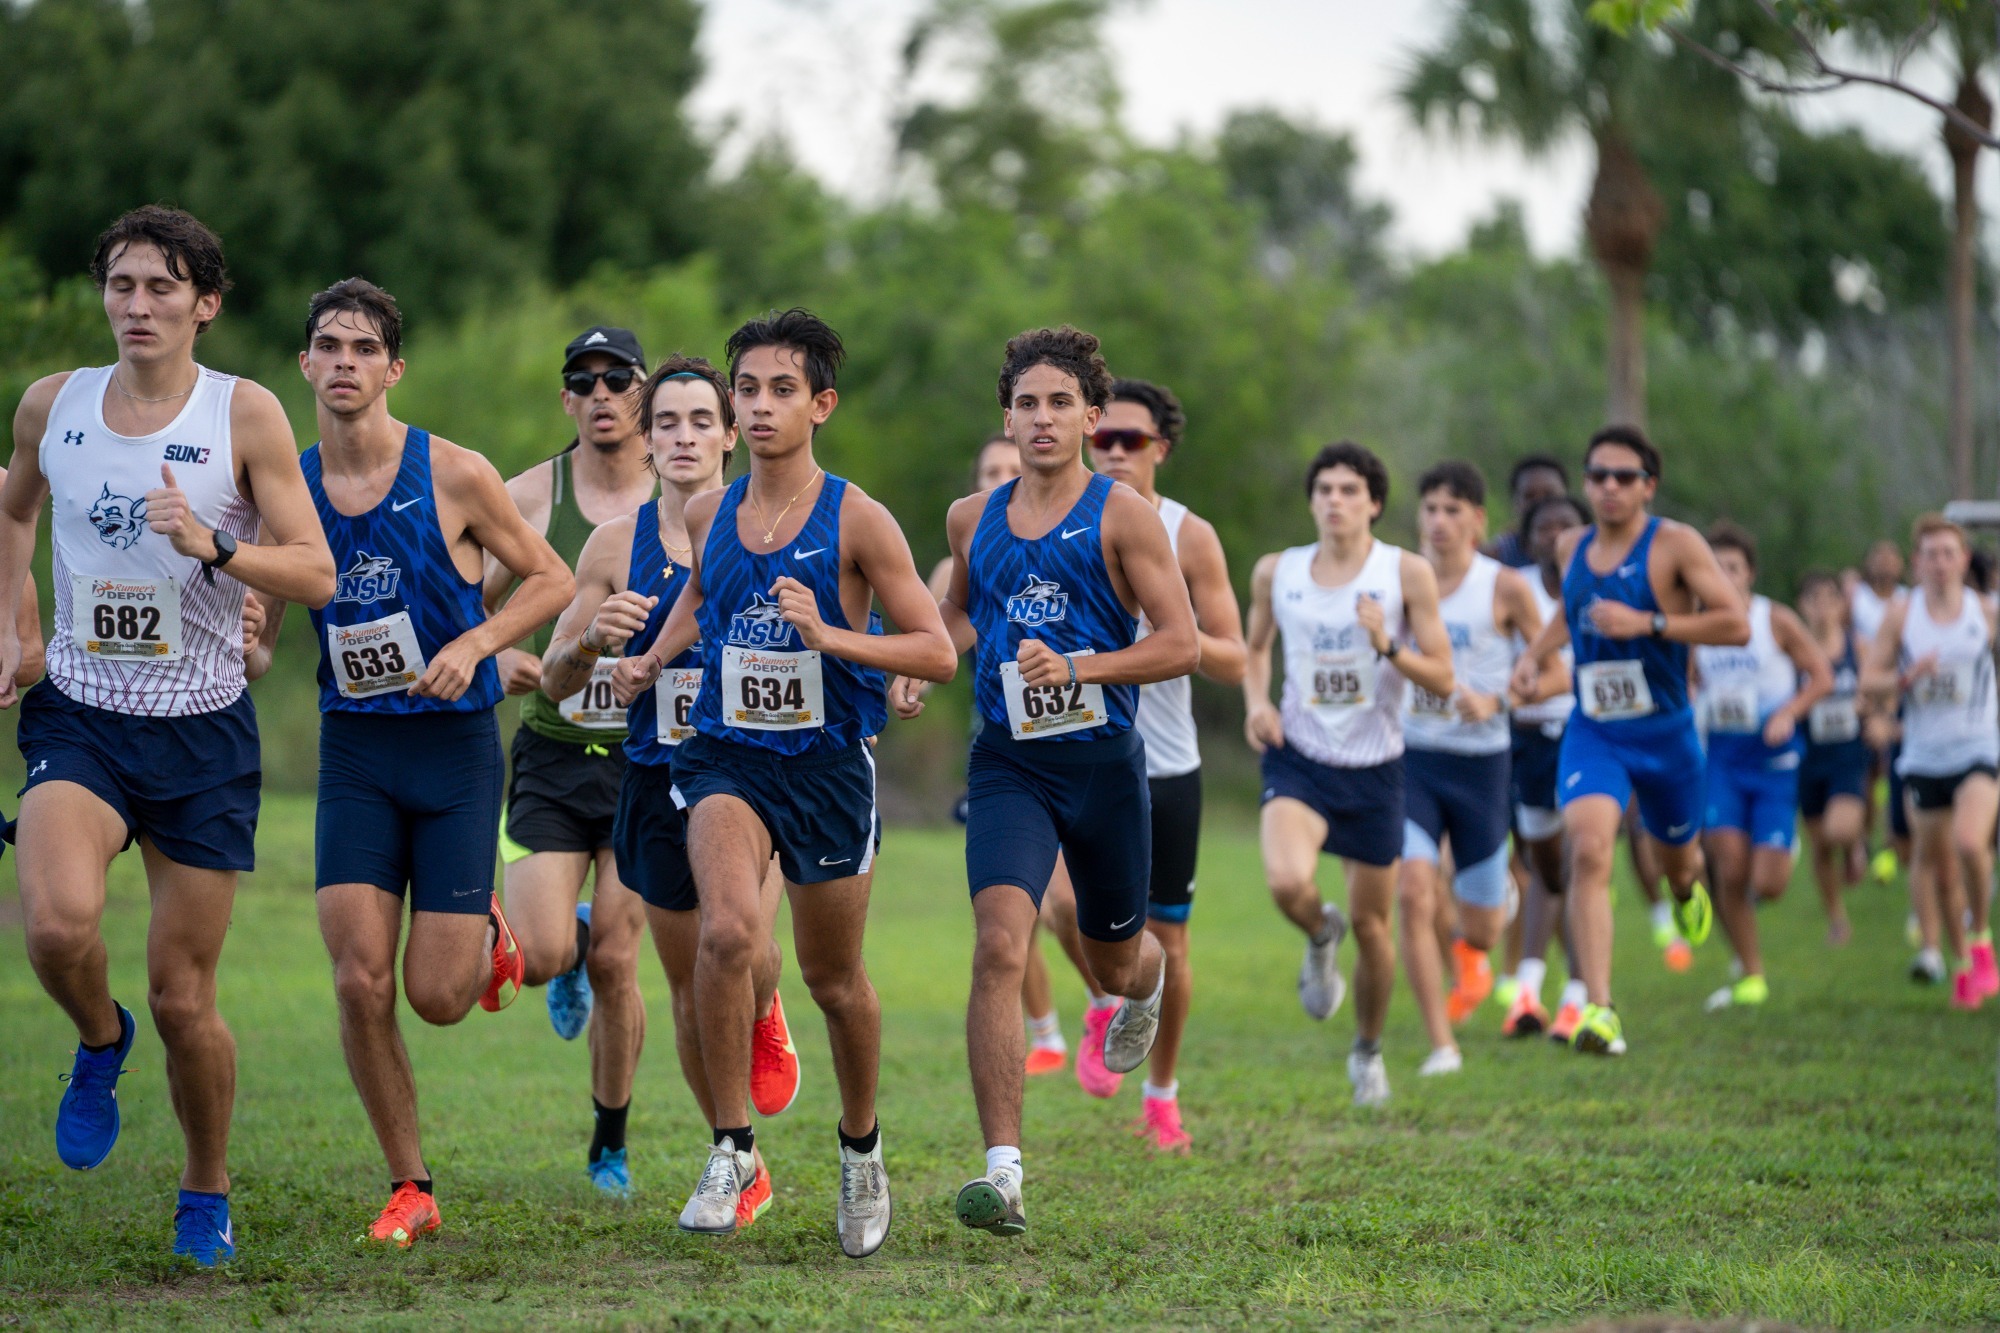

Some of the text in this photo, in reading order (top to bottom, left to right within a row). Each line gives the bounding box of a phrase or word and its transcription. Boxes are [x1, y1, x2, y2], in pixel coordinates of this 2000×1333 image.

[107, 591, 156, 601] DEPOT
[114, 583, 157, 593] Runner's
[336, 571, 399, 602] NSU
[93, 603, 161, 641] 682
[1008, 595, 1068, 624] NSU
[348, 630, 390, 646] DEPOT
[353, 624, 390, 638] Runner's
[729, 617, 794, 646] NSU
[341, 642, 406, 681] 633
[752, 664, 798, 673] DEPOT
[759, 656, 799, 666] Runner's
[741, 675, 805, 711] 634
[1313, 670, 1360, 694] 695
[1022, 683, 1086, 719] 632
